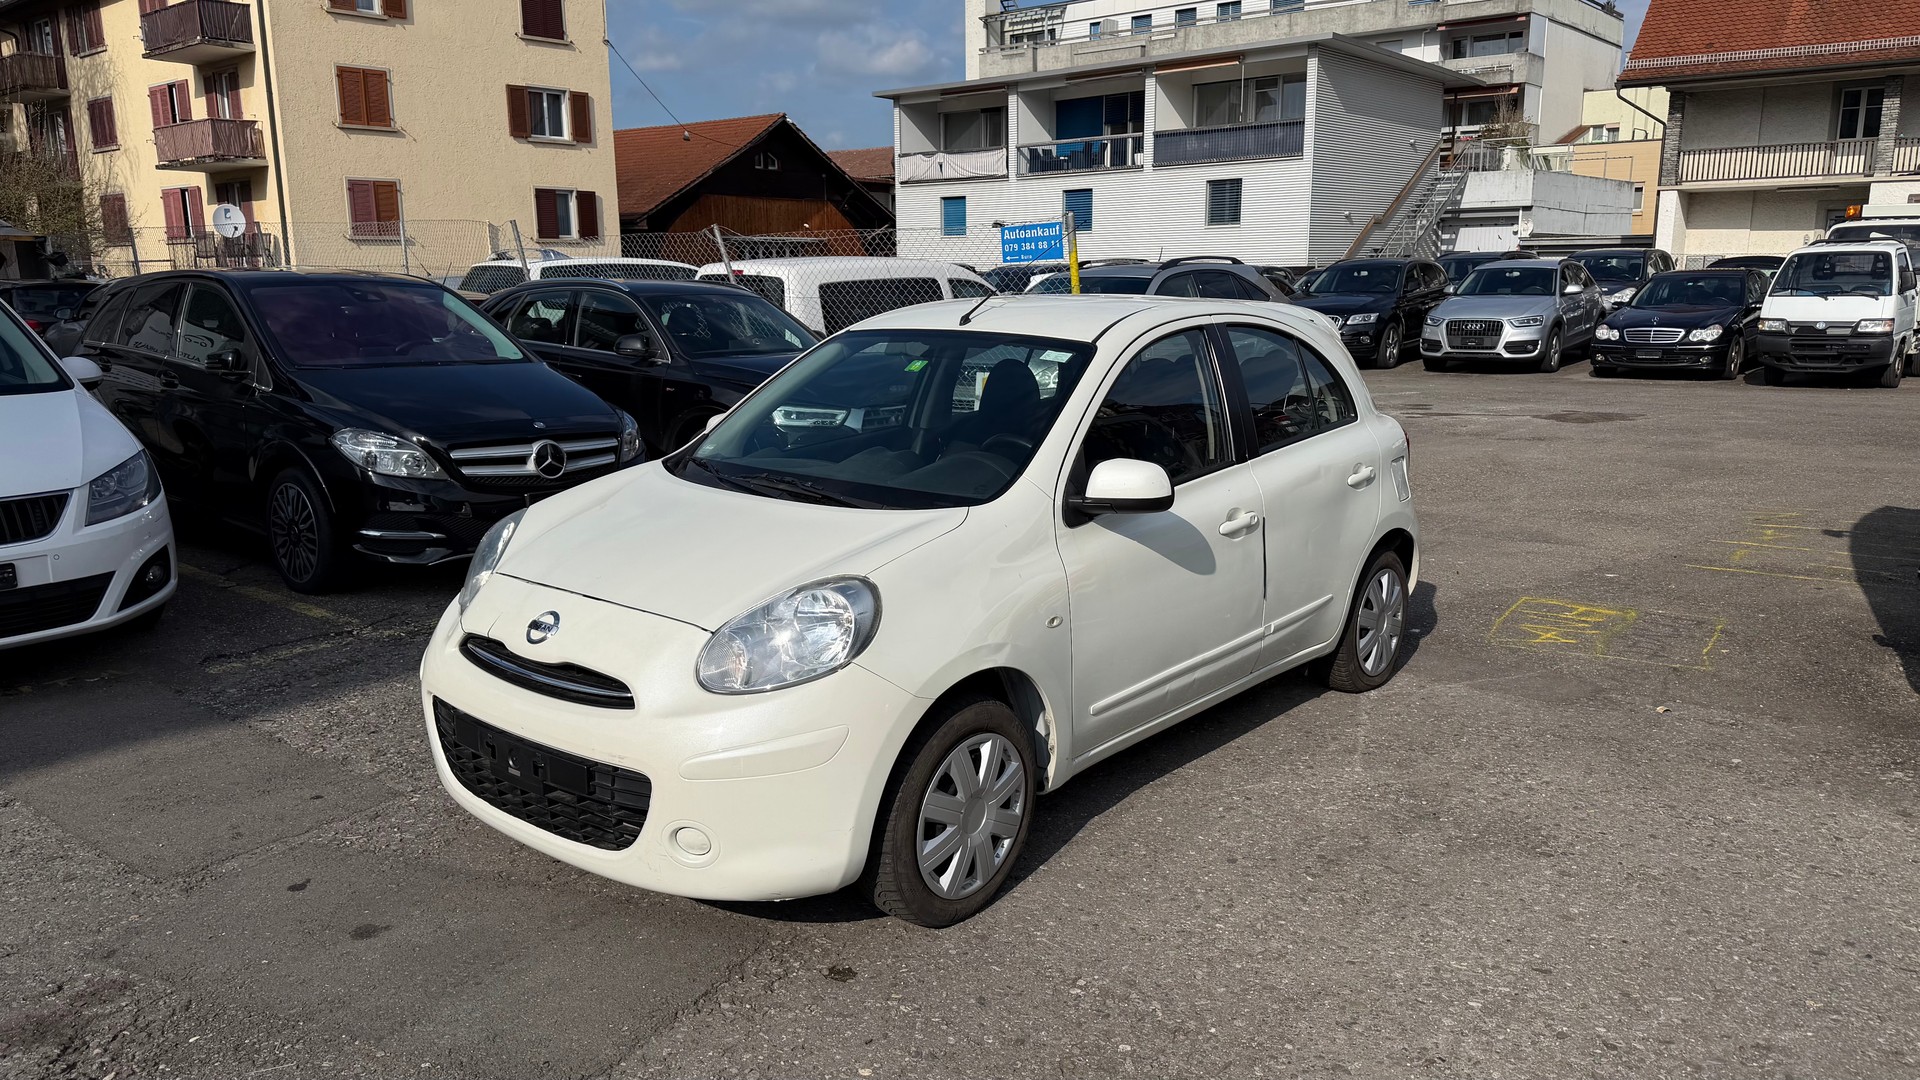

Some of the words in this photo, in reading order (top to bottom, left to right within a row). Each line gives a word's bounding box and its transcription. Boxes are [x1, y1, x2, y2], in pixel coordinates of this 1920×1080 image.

[1004, 225, 1060, 240] Autoankauf
[1004, 243, 1018, 252] 079
[1021, 242, 1035, 251] 384
[1038, 240, 1048, 249] 88
